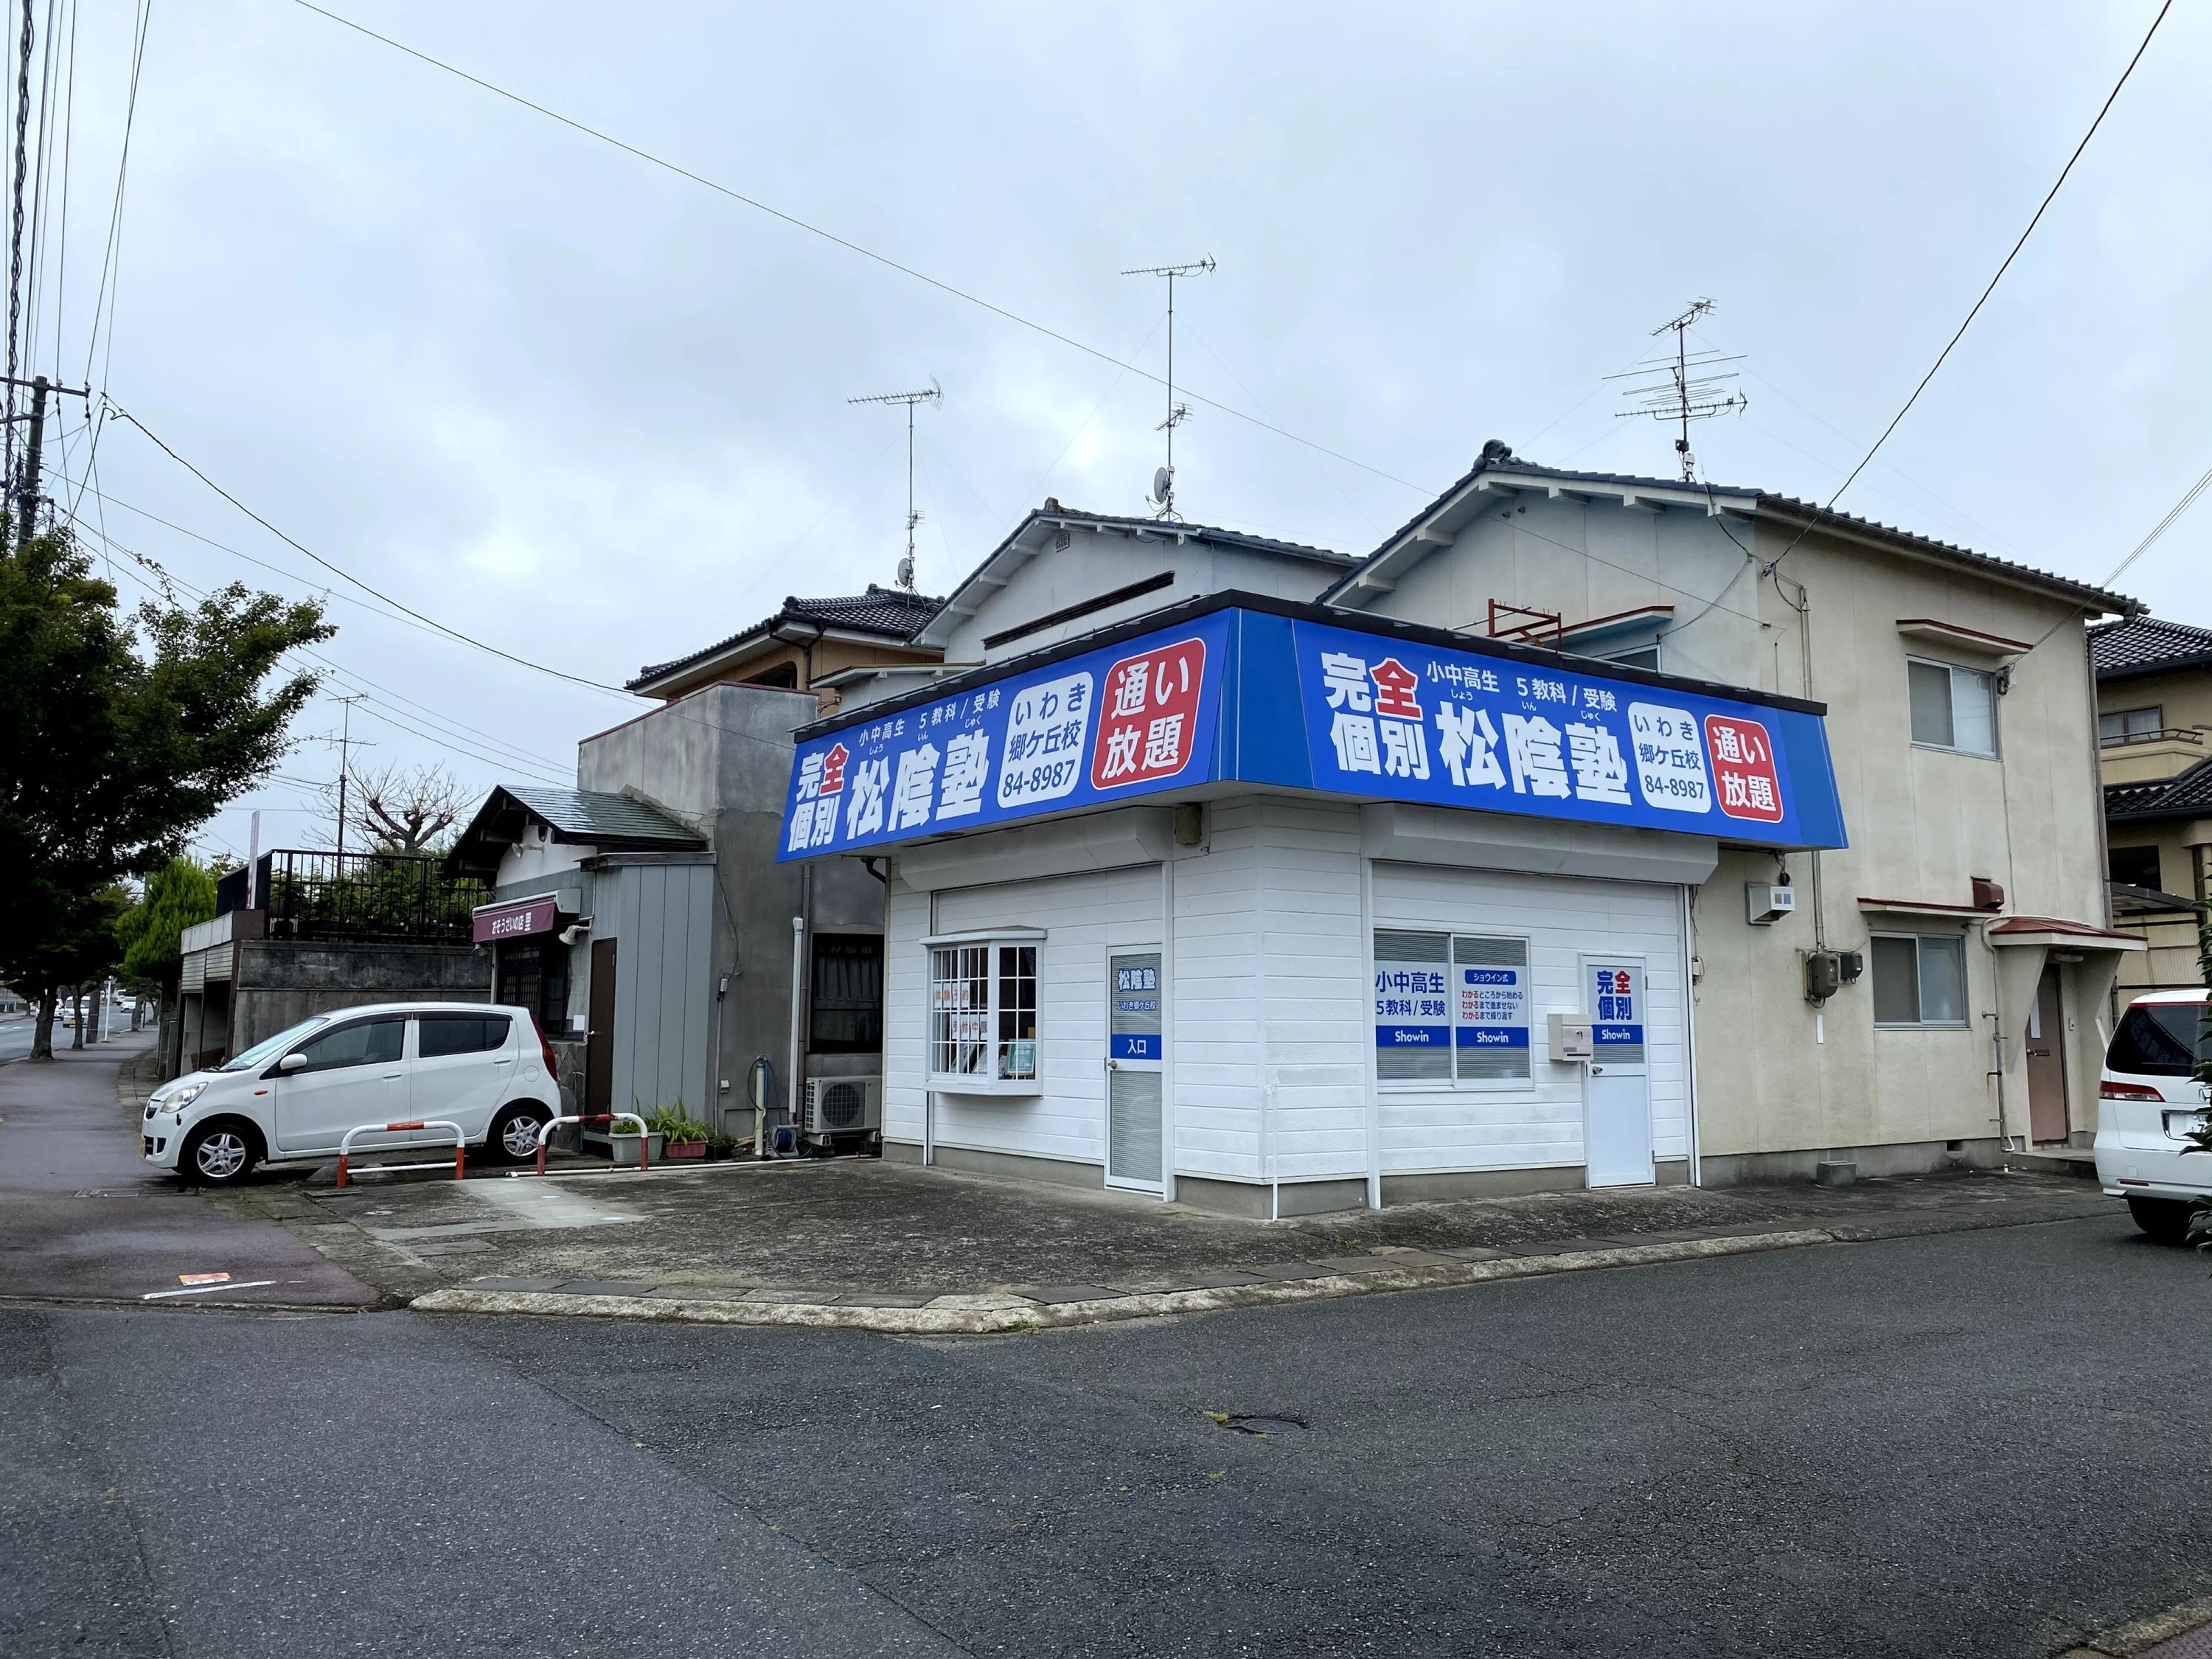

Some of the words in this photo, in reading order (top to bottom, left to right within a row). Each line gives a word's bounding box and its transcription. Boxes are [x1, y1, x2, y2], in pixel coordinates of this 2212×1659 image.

[1110, 656, 1189, 720] 通い
[1321, 652, 1424, 722] 完全
[1426, 661, 1500, 693] 小中高生
[1015, 683, 1086, 726] いわき
[1450, 688, 1473, 700] しょう
[1522, 701, 1537, 712] いん
[1581, 709, 1601, 721] じゅく
[859, 718, 905, 747] 小中高生
[1634, 714, 1694, 741] いわき
[1101, 712, 1185, 780] 放題
[1329, 710, 1430, 780] 個別
[1435, 701, 1632, 806] 松陰塾
[1712, 726, 1767, 765] 通い
[796, 742, 849, 802] 完全
[846, 728, 990, 841] 松陰塾
[1003, 759, 1076, 798] 84-8987
[1645, 775, 1704, 799] 84-8987
[1721, 771, 1776, 811] 放題
[787, 795, 841, 852] 個別
[1118, 967, 1156, 991] 松陰塾
[1375, 971, 1445, 993] 小中高生
[1473, 973, 1509, 983] ショウイン式
[1597, 970, 1631, 995] 完全
[1377, 999, 1446, 1016] 5教科/受験
[1462, 990, 1523, 1000] わかるところから始める
[1462, 1001, 1519, 1010] わかるまで進ませない
[1598, 996, 1632, 1020] 個別
[1462, 1012, 1513, 1020] わかるまで繰り返す
[1127, 1039, 1147, 1054] 入口
[1395, 1030, 1430, 1043] Showin
[1476, 1031, 1509, 1043] Showin
[1601, 1029, 1631, 1040] Showin
